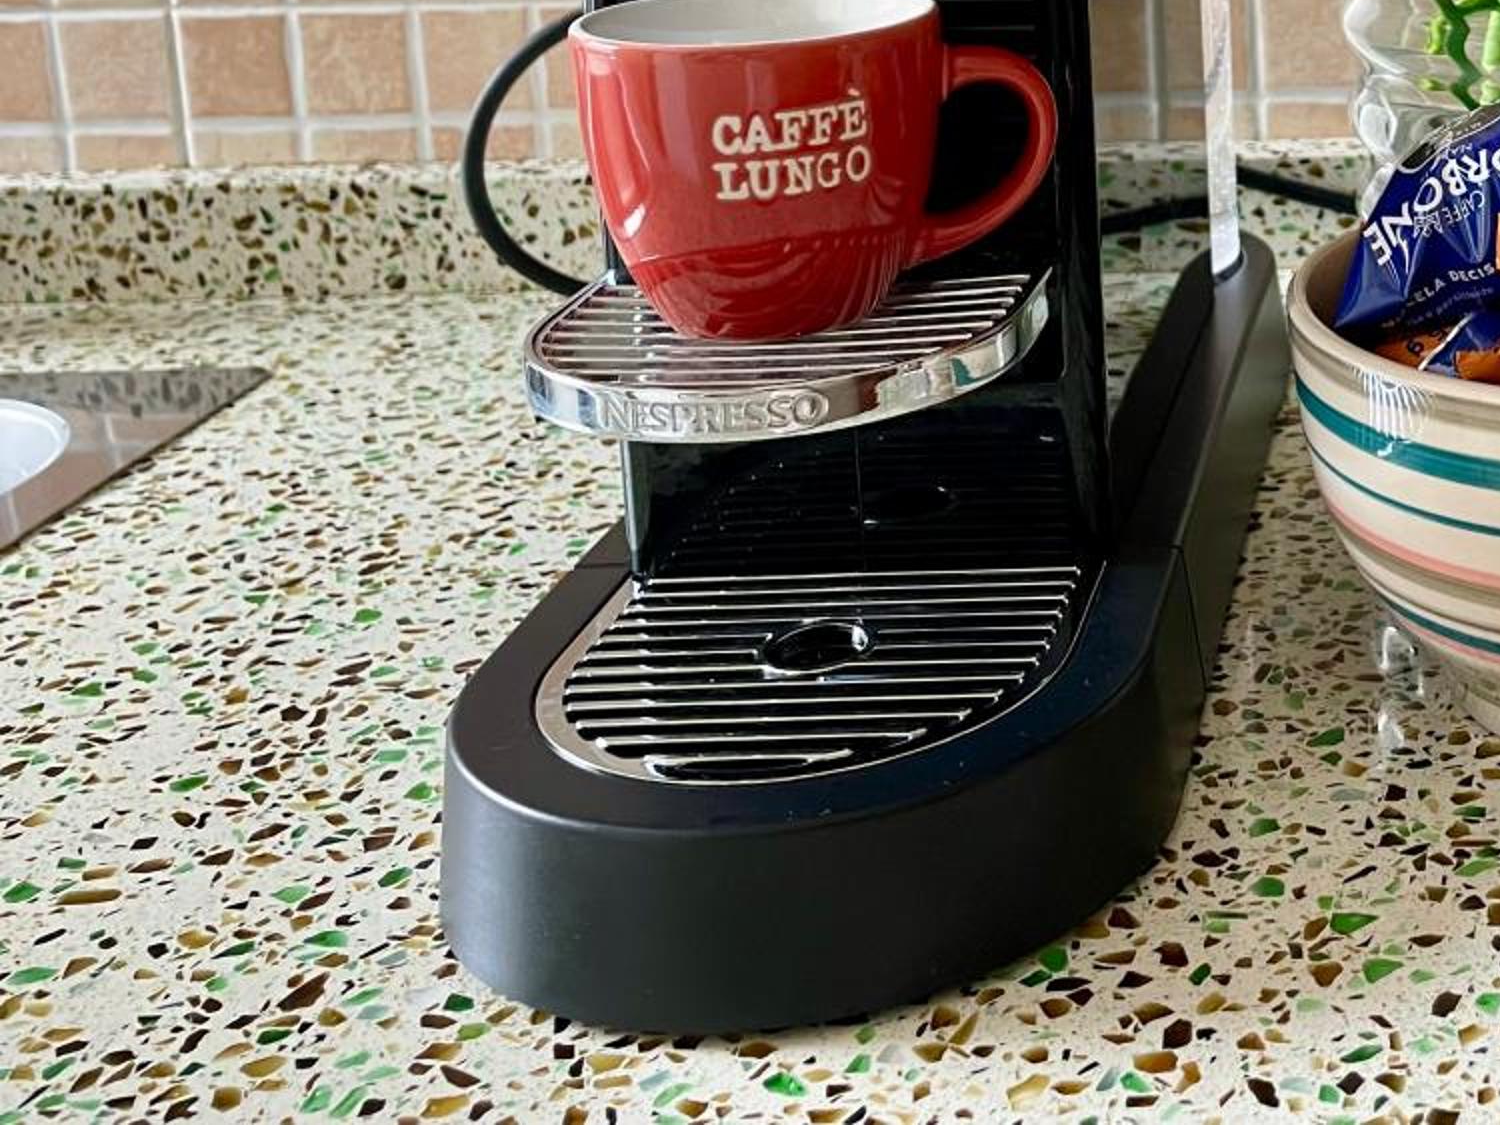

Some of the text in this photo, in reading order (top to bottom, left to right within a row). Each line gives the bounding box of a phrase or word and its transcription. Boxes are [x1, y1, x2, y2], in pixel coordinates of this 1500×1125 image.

[712, 88, 867, 156] CAFFÈ
[713, 144, 872, 201] LUNGO
[1449, 261, 1496, 282] DECIS
[602, 390, 829, 433] NESPRESSO
